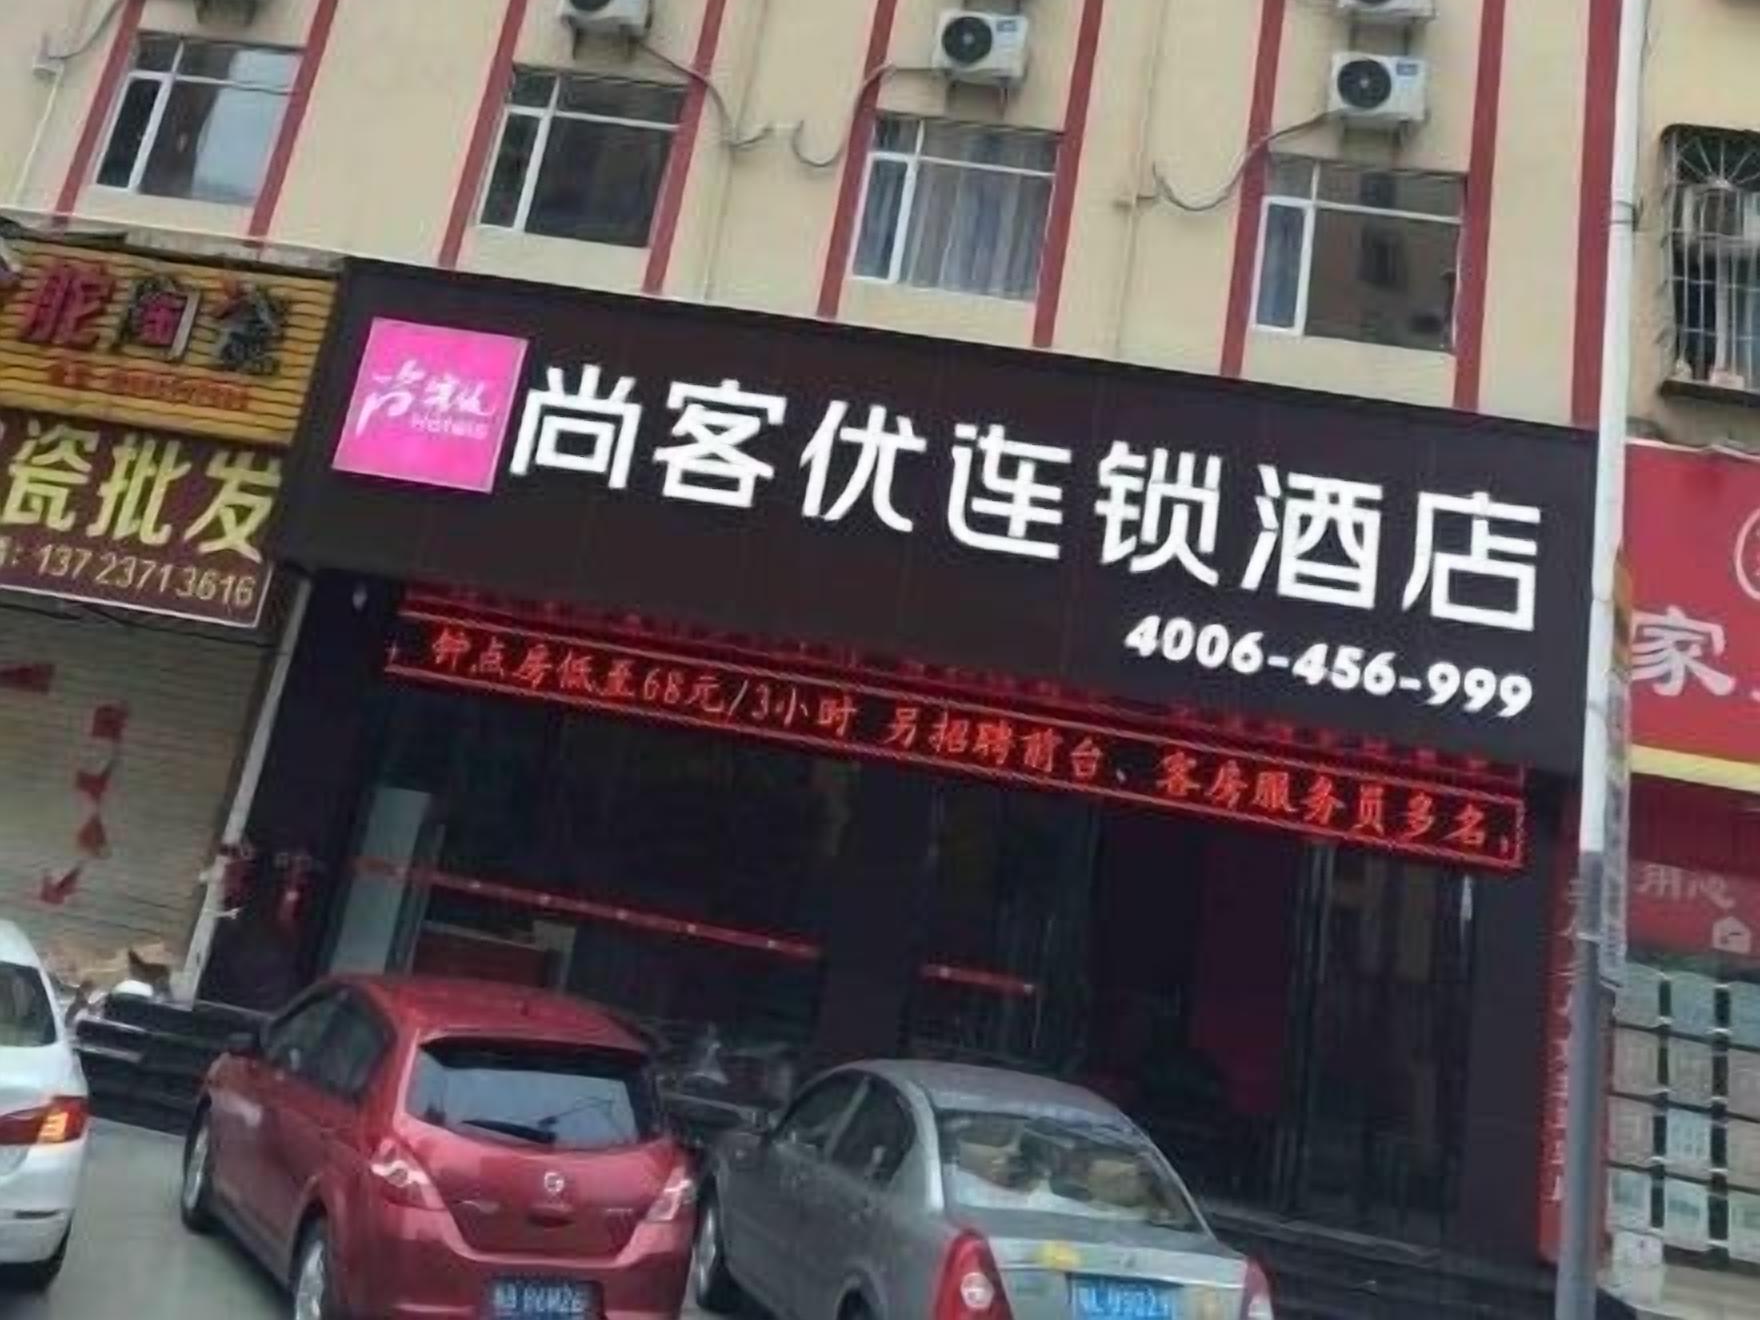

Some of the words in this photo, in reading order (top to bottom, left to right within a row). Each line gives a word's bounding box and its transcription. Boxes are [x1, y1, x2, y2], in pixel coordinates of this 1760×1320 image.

[0, 418, 281, 563] 瓷批发
[508, 364, 1542, 633] 尚客优连锁酒店
[1125, 615, 1535, 718] 4006-456-999
[1631, 605, 1760, 702] 家
